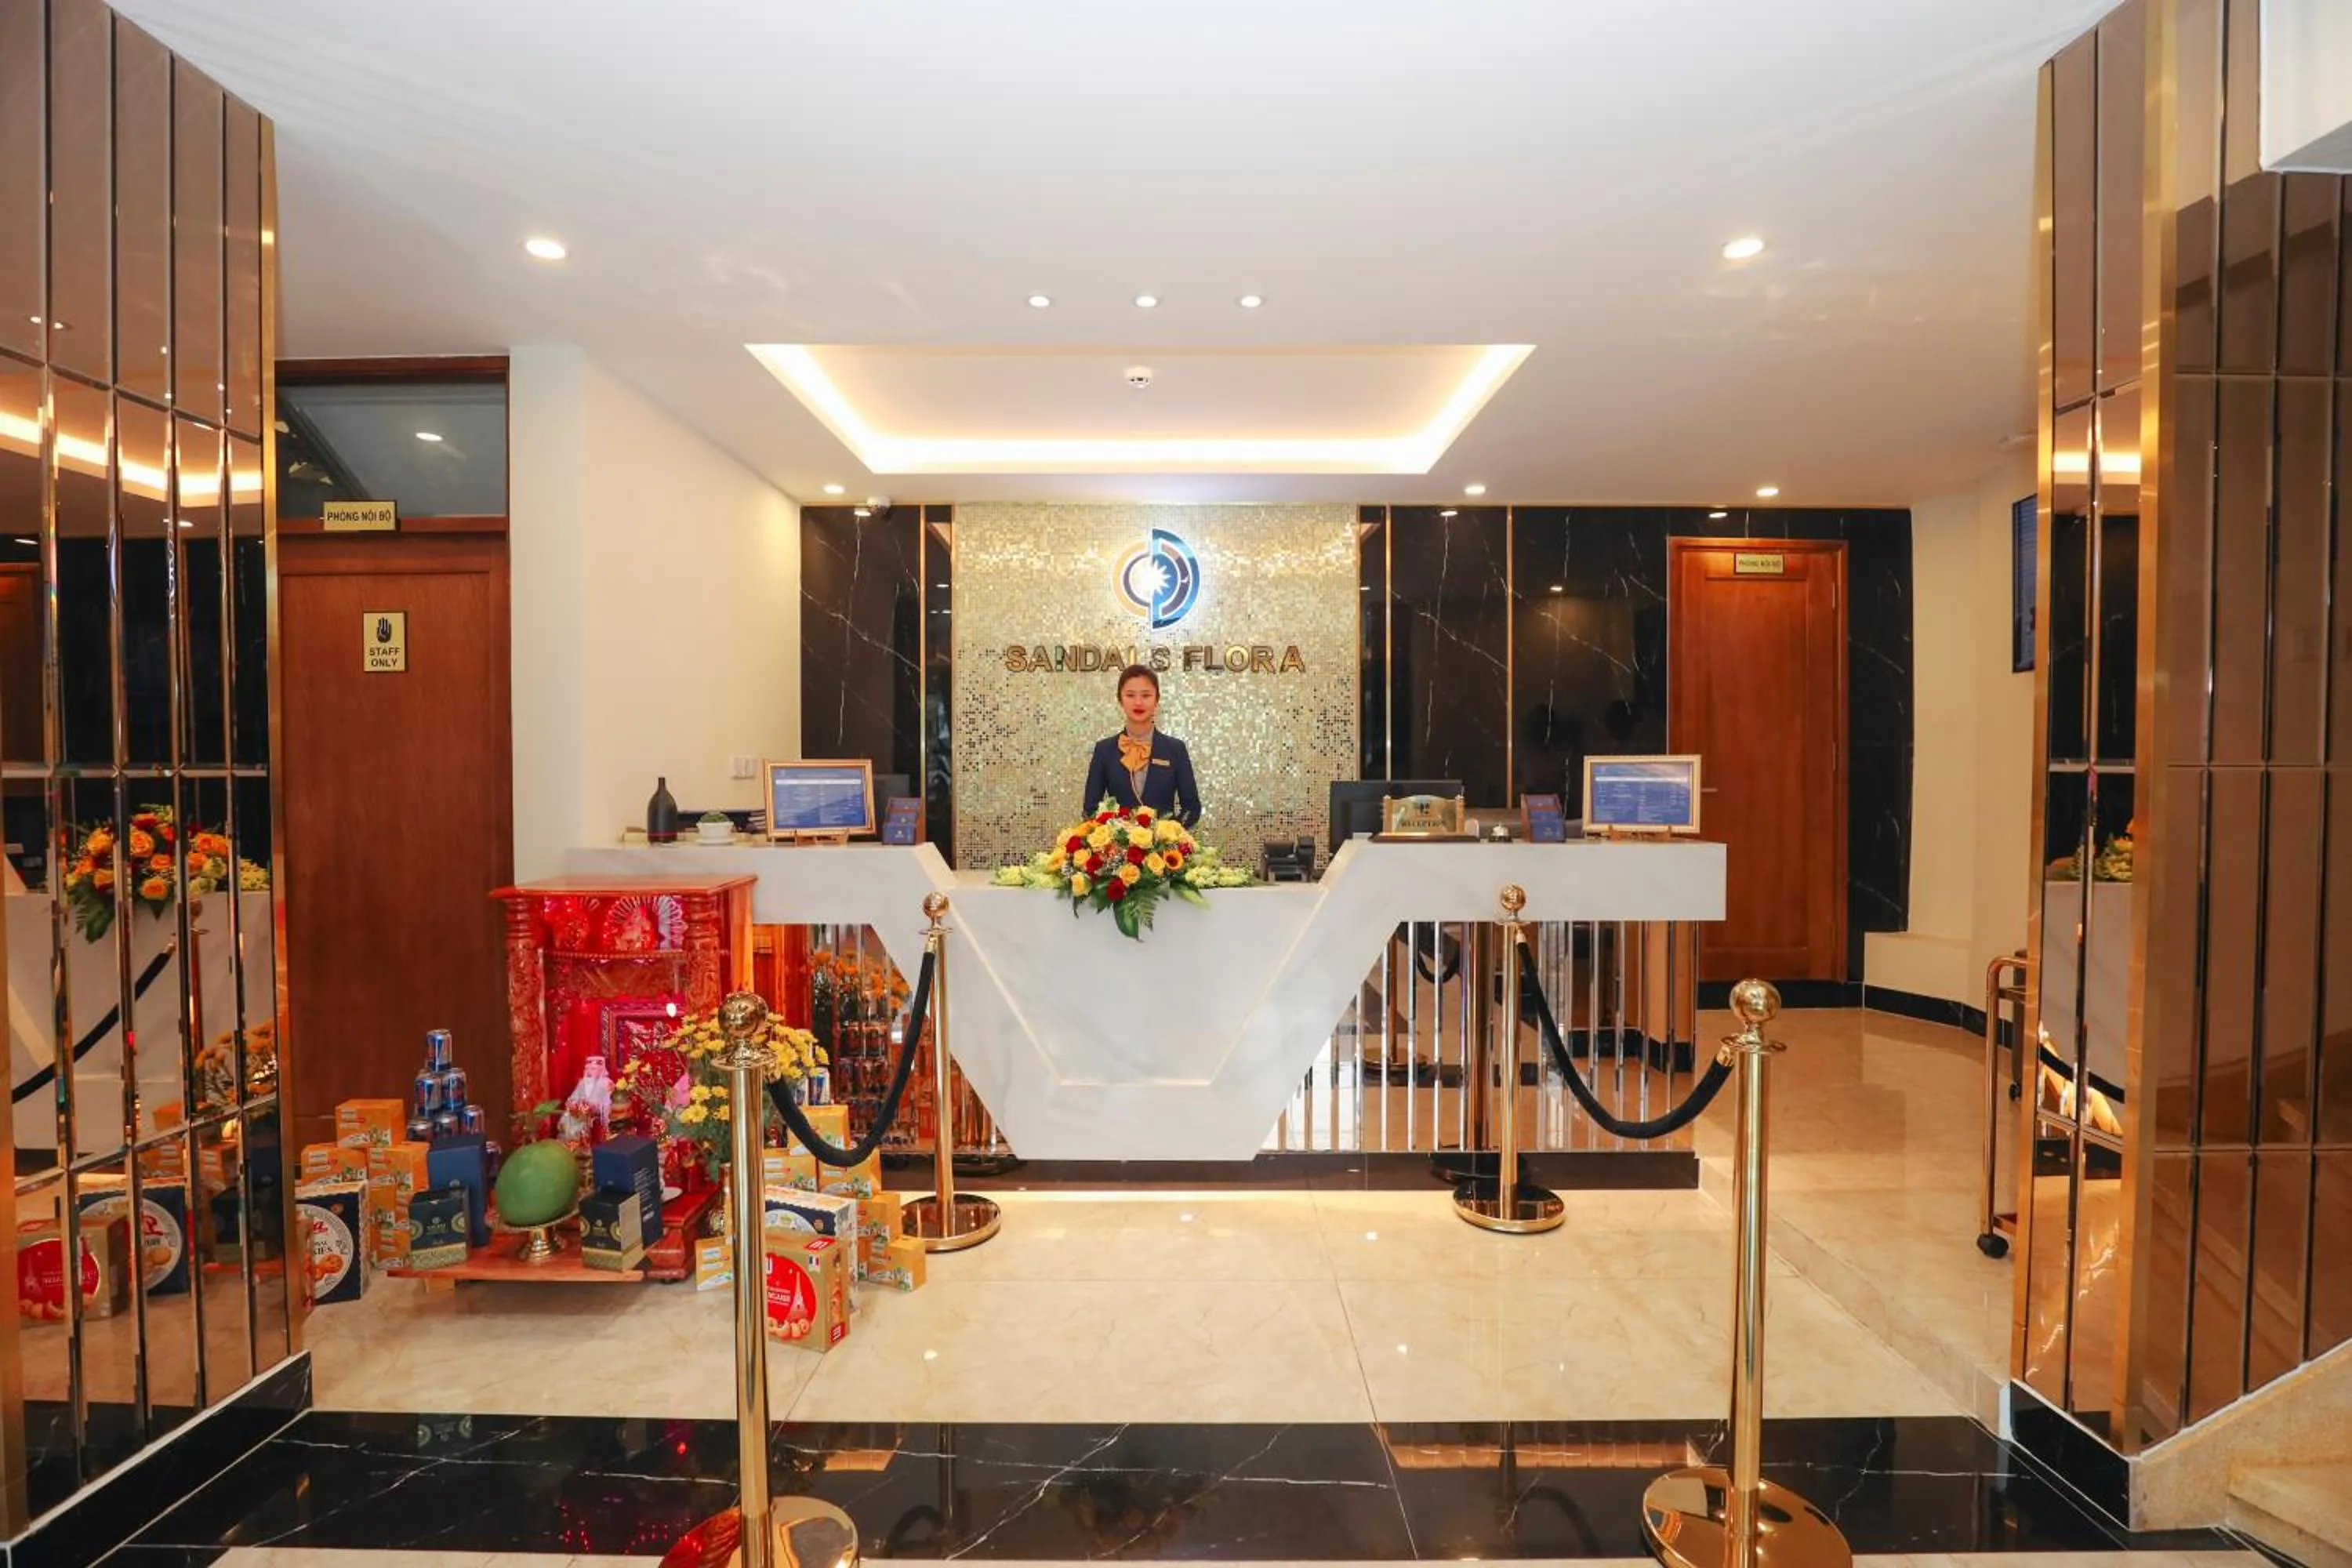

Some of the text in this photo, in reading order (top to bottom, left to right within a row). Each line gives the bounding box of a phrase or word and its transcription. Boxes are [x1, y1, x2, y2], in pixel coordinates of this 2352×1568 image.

[369, 647, 401, 656] STAFF
[371, 659, 398, 667] ONLY
[1182, 645, 1306, 673] FLORA
